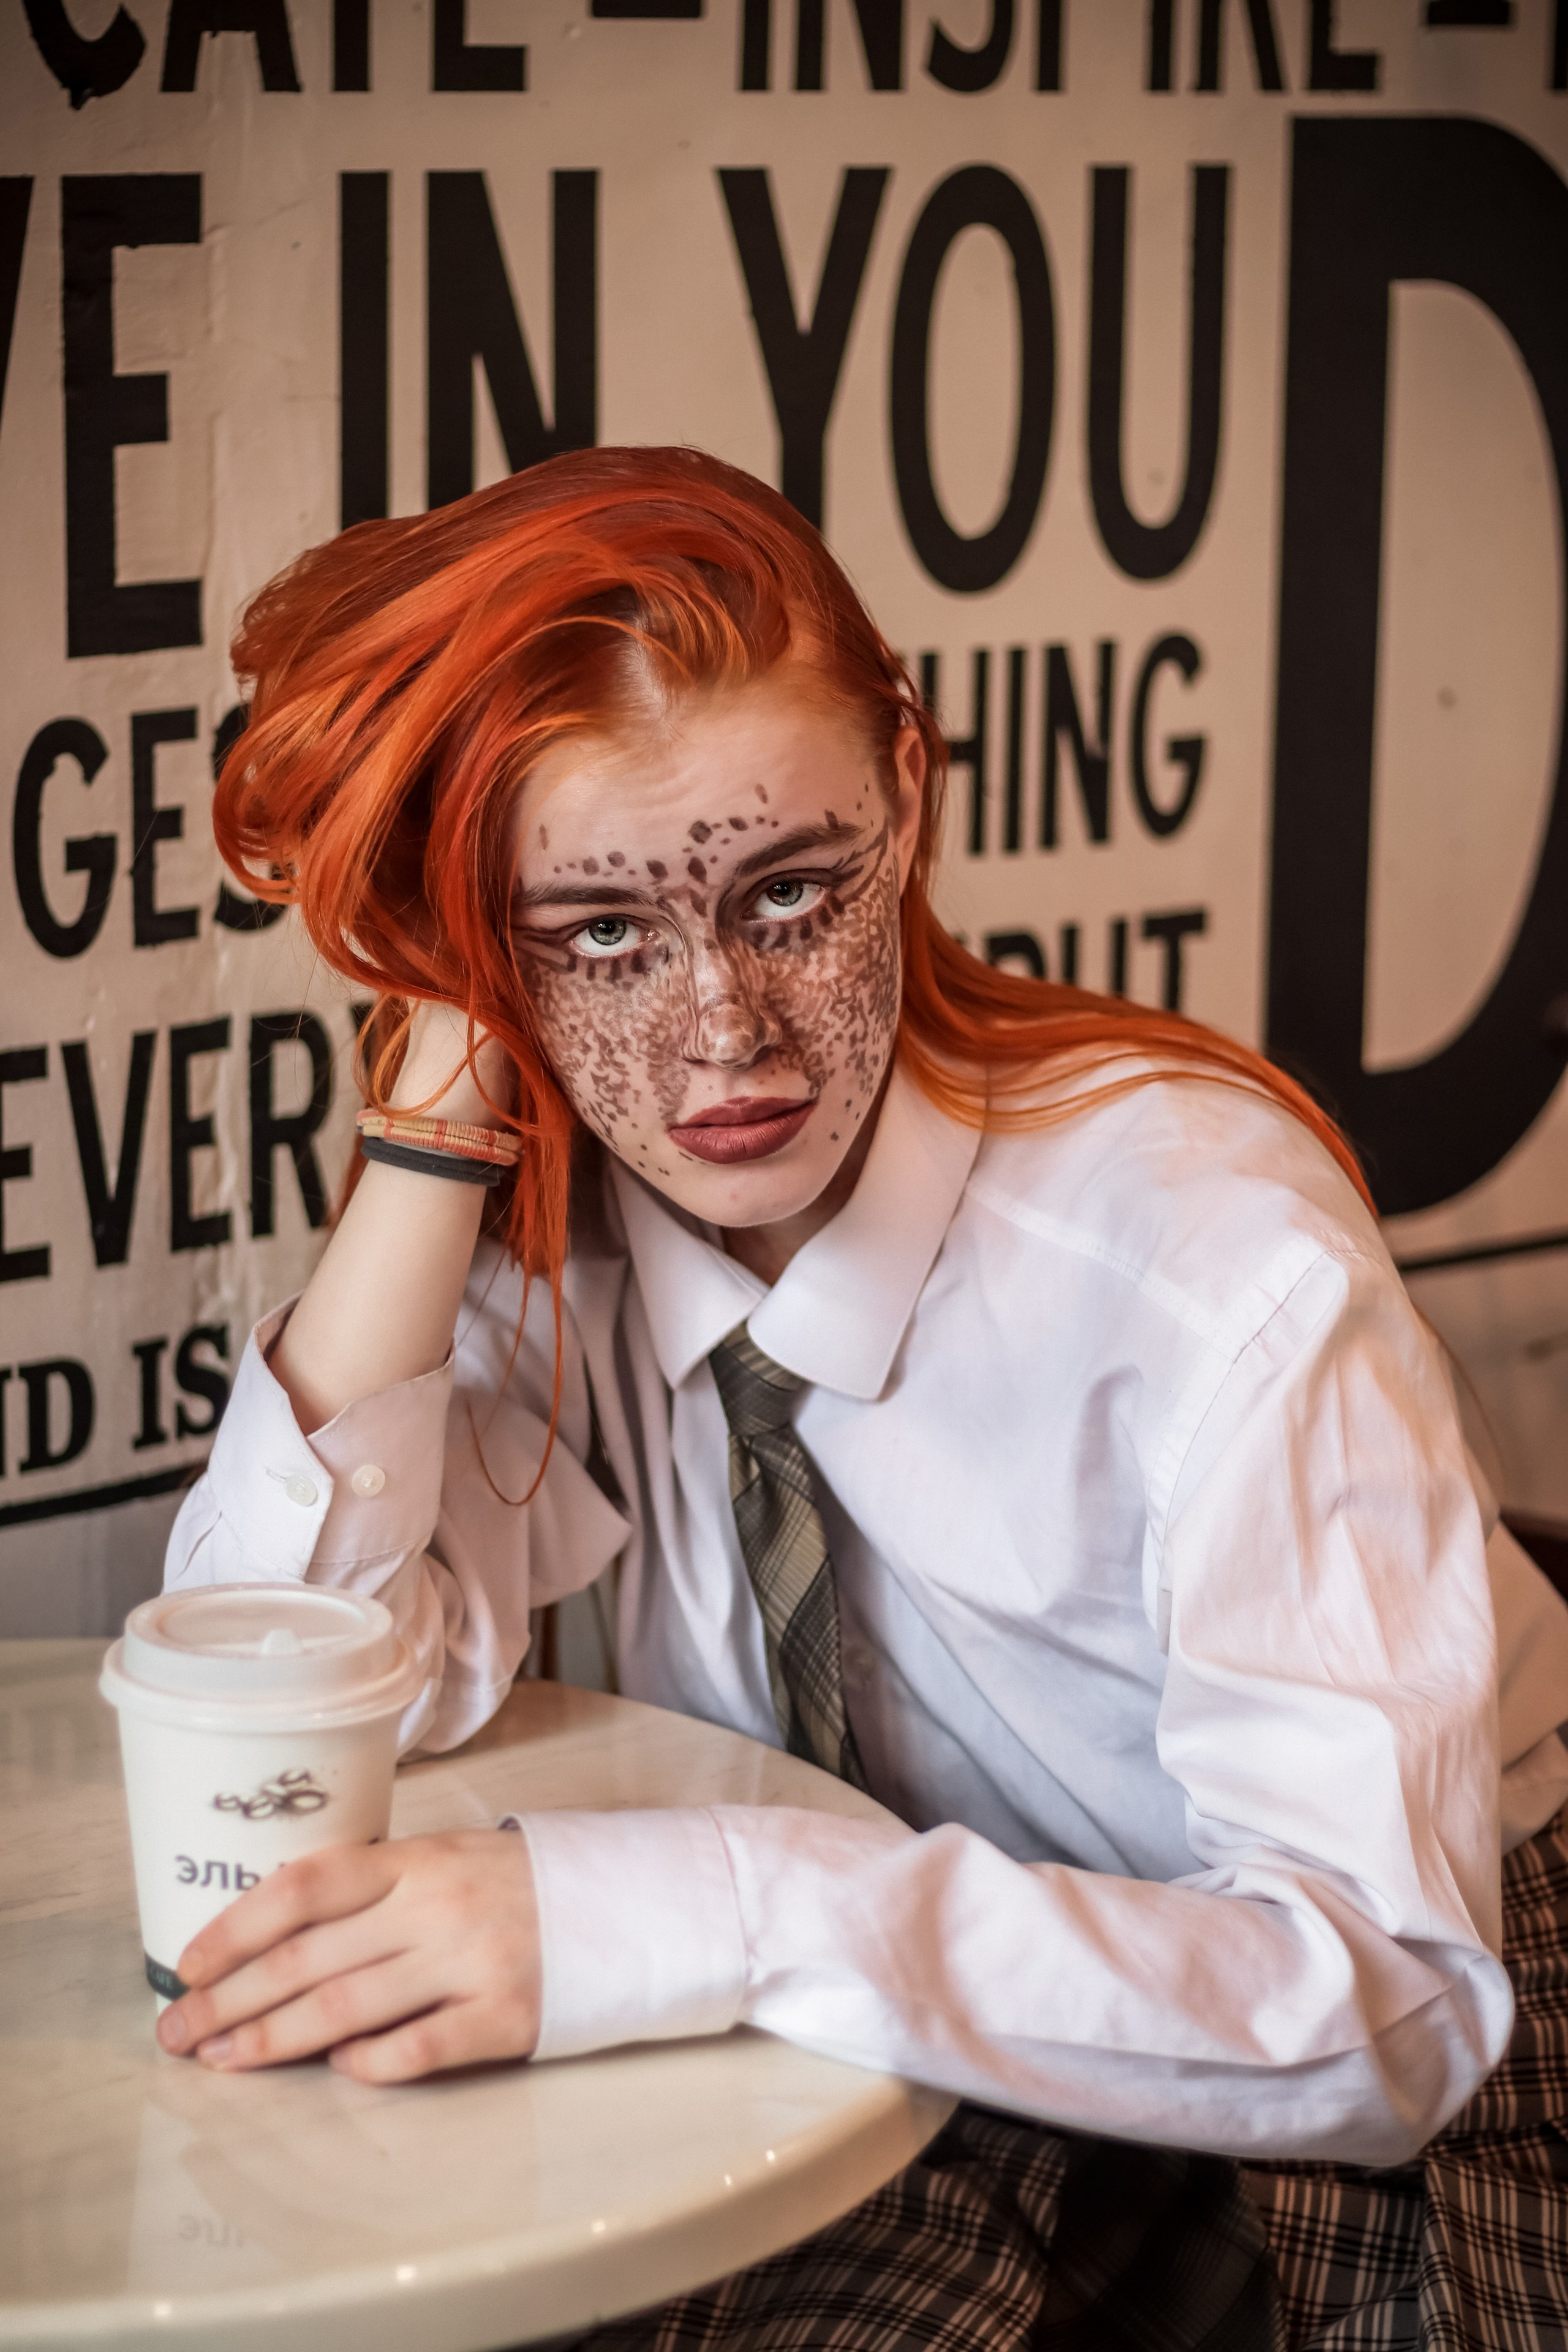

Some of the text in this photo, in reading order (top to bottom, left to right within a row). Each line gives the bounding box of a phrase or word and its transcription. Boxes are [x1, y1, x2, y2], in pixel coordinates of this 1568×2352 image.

[0, 162, 1234, 659] E IN YOU
[0, 1001, 379, 1283] EVER
[0, 1322, 230, 1477] D IS
